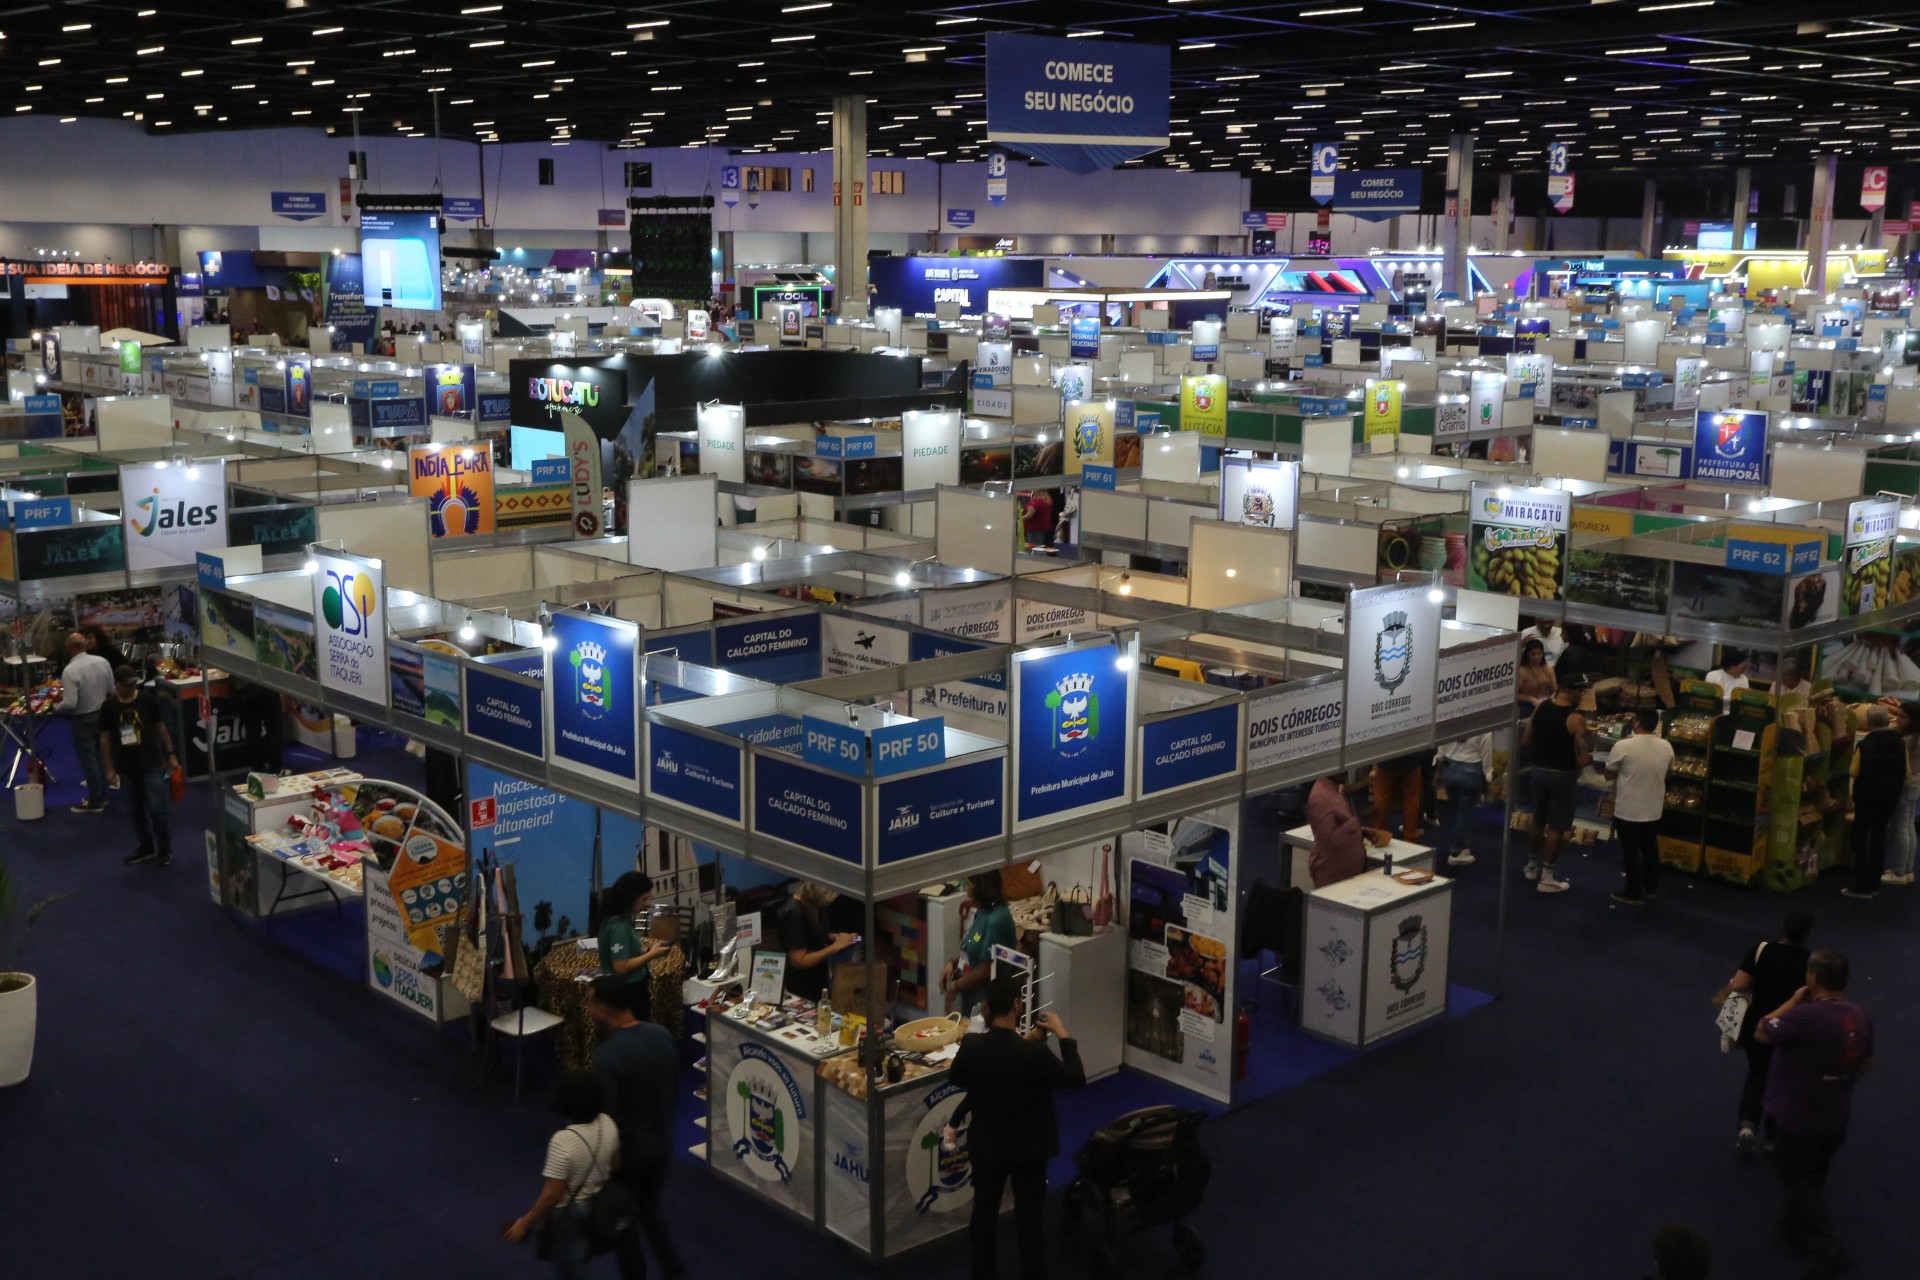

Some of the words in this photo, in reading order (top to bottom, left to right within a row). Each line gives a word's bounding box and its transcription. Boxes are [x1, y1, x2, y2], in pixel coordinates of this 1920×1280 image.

[1045, 61, 1114, 83] COMECE
[1024, 91, 1056, 111] SEU
[1060, 89, 1134, 114] NEGÓCIO
[994, 153, 1006, 177] B
[1319, 146, 1337, 174] C
[1556, 146, 1567, 173] 3
[729, 169, 739, 188] 3
[1361, 179, 1394, 188] COMECE
[1869, 170, 1886, 189] C
[1368, 189, 1404, 200] NEGÓCIO
[9, 262, 38, 276] SUA
[42, 262, 81, 276] IDEIA
[83, 263, 103, 276] DE
[105, 260, 170, 276] NEGÓCIO
[529, 377, 600, 408] BOTUCATU
[976, 400, 1009, 411] CIDADE
[1438, 417, 1466, 433] Grama
[707, 440, 736, 451] PIEDADE
[817, 442, 831, 450] PRF
[847, 443, 863, 453] PRF
[913, 446, 950, 465] PIEDADE
[536, 467, 555, 481] PRF
[557, 465, 566, 478] 12
[573, 441, 592, 506] LUDY'S
[1697, 465, 1761, 483] MAIRIPORÃ
[1698, 459, 1744, 470] PREFEITURA
[1749, 462, 1760, 473] DE
[1086, 472, 1103, 483] PRF
[1103, 473, 1113, 484] 61
[24, 508, 52, 520] PRF
[53, 507, 62, 518] 7
[1505, 505, 1562, 523] MIRACATU
[1572, 520, 1610, 533] ATUREZA
[42, 547, 100, 565] JALES
[1732, 548, 1759, 563] PRF
[1763, 552, 1781, 566] 62
[1793, 552, 1808, 564] PRF
[1808, 550, 1819, 562] 62
[1026, 614, 1045, 626] DOIS
[1046, 606, 1085, 622] CÓRREGOS
[744, 630, 778, 644] CAPITAL
[779, 628, 792, 638] DO
[957, 620, 999, 637] CÓRREGOS
[328, 634, 374, 659] ASSOCIAÇÃO
[726, 643, 767, 659] CALÇADO
[768, 636, 808, 652] FEMININO
[329, 650, 350, 666] SERRA
[351, 658, 360, 669] do
[330, 664, 362, 686] ITAQUERI
[1438, 678, 1462, 695] DOIS
[1463, 660, 1514, 687] CÓRREGOS
[486, 695, 508, 712] CAPITAL
[510, 703, 520, 715] DO
[939, 687, 994, 716] Prefeitura
[1371, 701, 1384, 714] DOIS
[1385, 694, 1411, 710] CÓRREGOS
[476, 703, 503, 721] CALÇADO
[503, 712, 532, 730] FEMININO
[1249, 718, 1279, 739] DOIS
[1280, 700, 1341, 731] CÓRREGOS
[562, 728, 584, 743] Prefeitura
[584, 735, 606, 751] Municipal
[606, 742, 614, 752] de
[613, 744, 626, 756] Jahu
[748, 725, 781, 744] cidade
[1170, 737, 1200, 751] CAPITAL
[1200, 733, 1212, 744] DO
[1248, 735, 1278, 753] MUNICÍPIO
[1278, 732, 1286, 743] DE
[1286, 725, 1314, 741] INTERESSE
[1315, 718, 1342, 735] TURÍSTICO
[807, 731, 836, 754] PRF
[840, 740, 860, 761] 50
[879, 737, 913, 762] PRF
[917, 731, 939, 753] 50
[1155, 749, 1190, 766] CALÇADO
[1190, 740, 1226, 757] FEMININO
[656, 757, 679, 773] JAHU
[684, 767, 707, 782] Cultura
[711, 776, 734, 790] Turismo
[1030, 781, 1061, 796] Prefeitura
[1061, 774, 1090, 790] Municipal
[1090, 773, 1099, 783] de
[1099, 768, 1114, 780] Jahu
[496, 794, 556, 816] majestosa
[784, 788, 816, 809] CAPITAL
[817, 800, 831, 813] DO
[929, 807, 958, 821] Cultura
[966, 797, 995, 812] Turismo
[494, 809, 554, 836] altaneira!
[768, 797, 806, 818] CALÇADO
[807, 808, 848, 831] FEMININO
[888, 811, 920, 831] JAHU
[394, 965, 419, 988] SERRA
[394, 979, 434, 1012] ITAQUERI
[1386, 1001, 1399, 1015] DOIS
[742, 1045, 768, 1061] Alçando
[767, 1057, 783, 1075] voos
[781, 1070, 792, 1086] ao
[787, 1083, 804, 1116] futuro
[834, 1152, 870, 1183] JAHU
